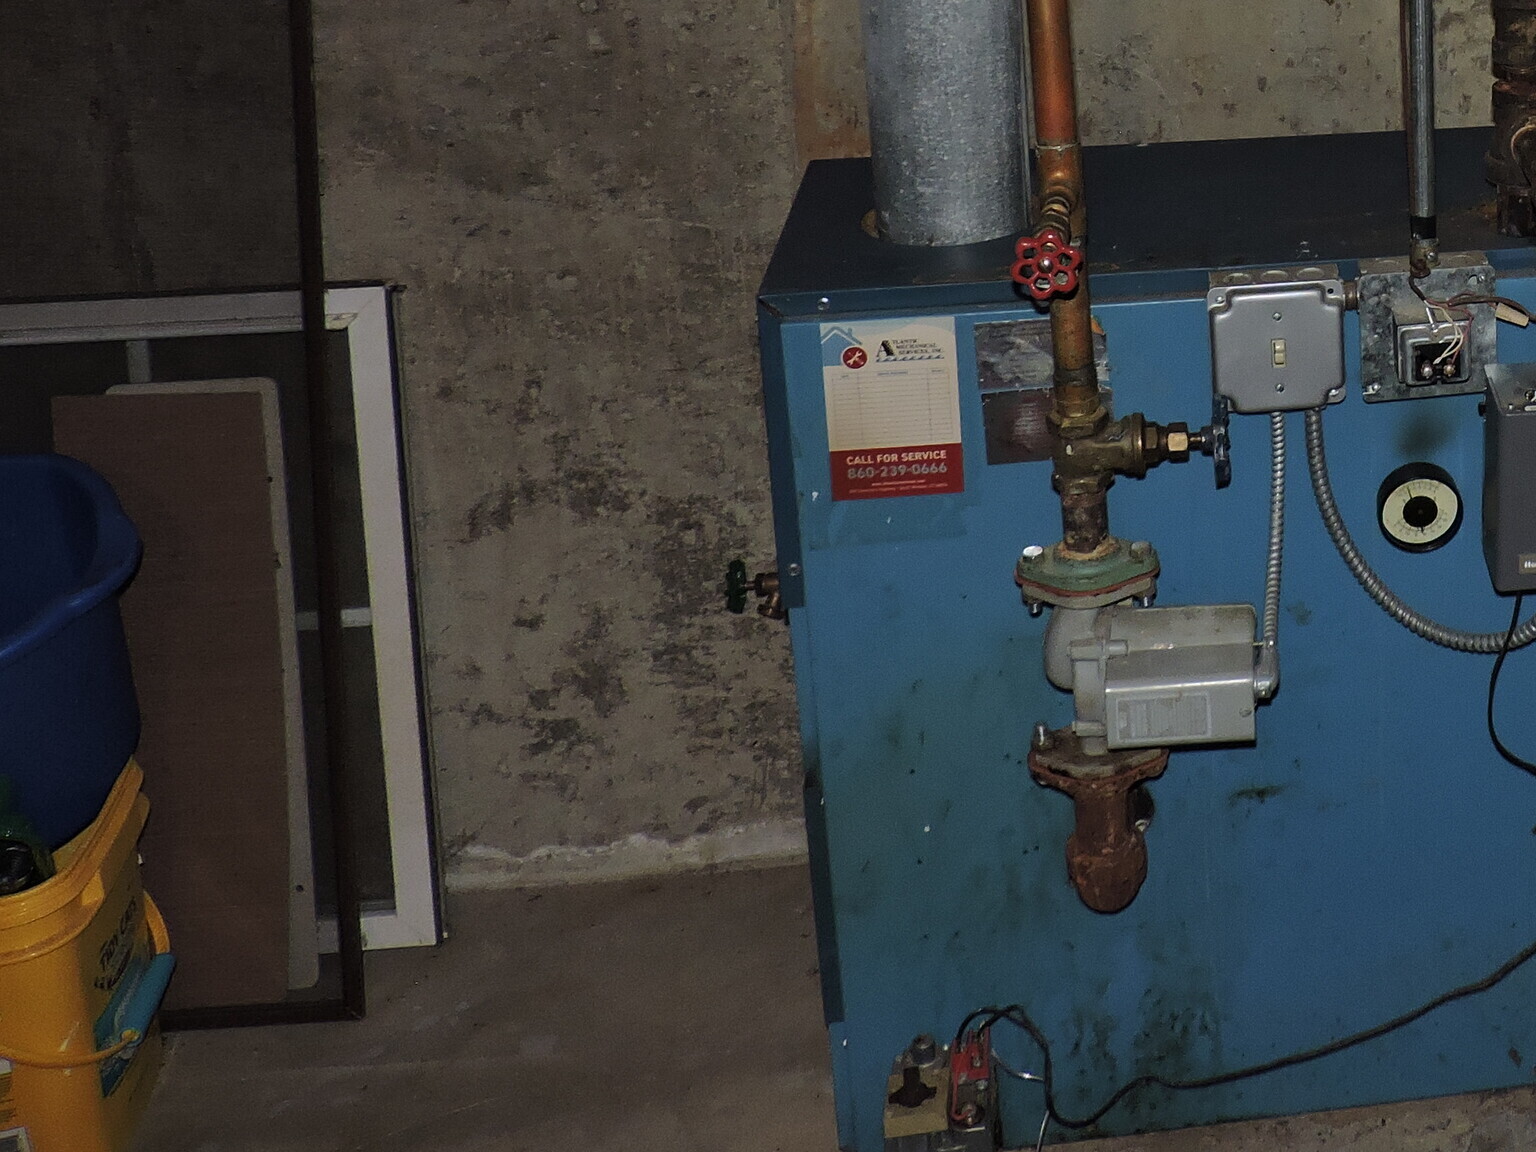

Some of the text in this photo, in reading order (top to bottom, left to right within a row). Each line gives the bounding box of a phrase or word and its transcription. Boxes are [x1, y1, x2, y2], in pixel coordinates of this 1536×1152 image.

[846, 449, 947, 465] CALL FOR SERVICE
[847, 462, 948, 479] 860-239-0666
